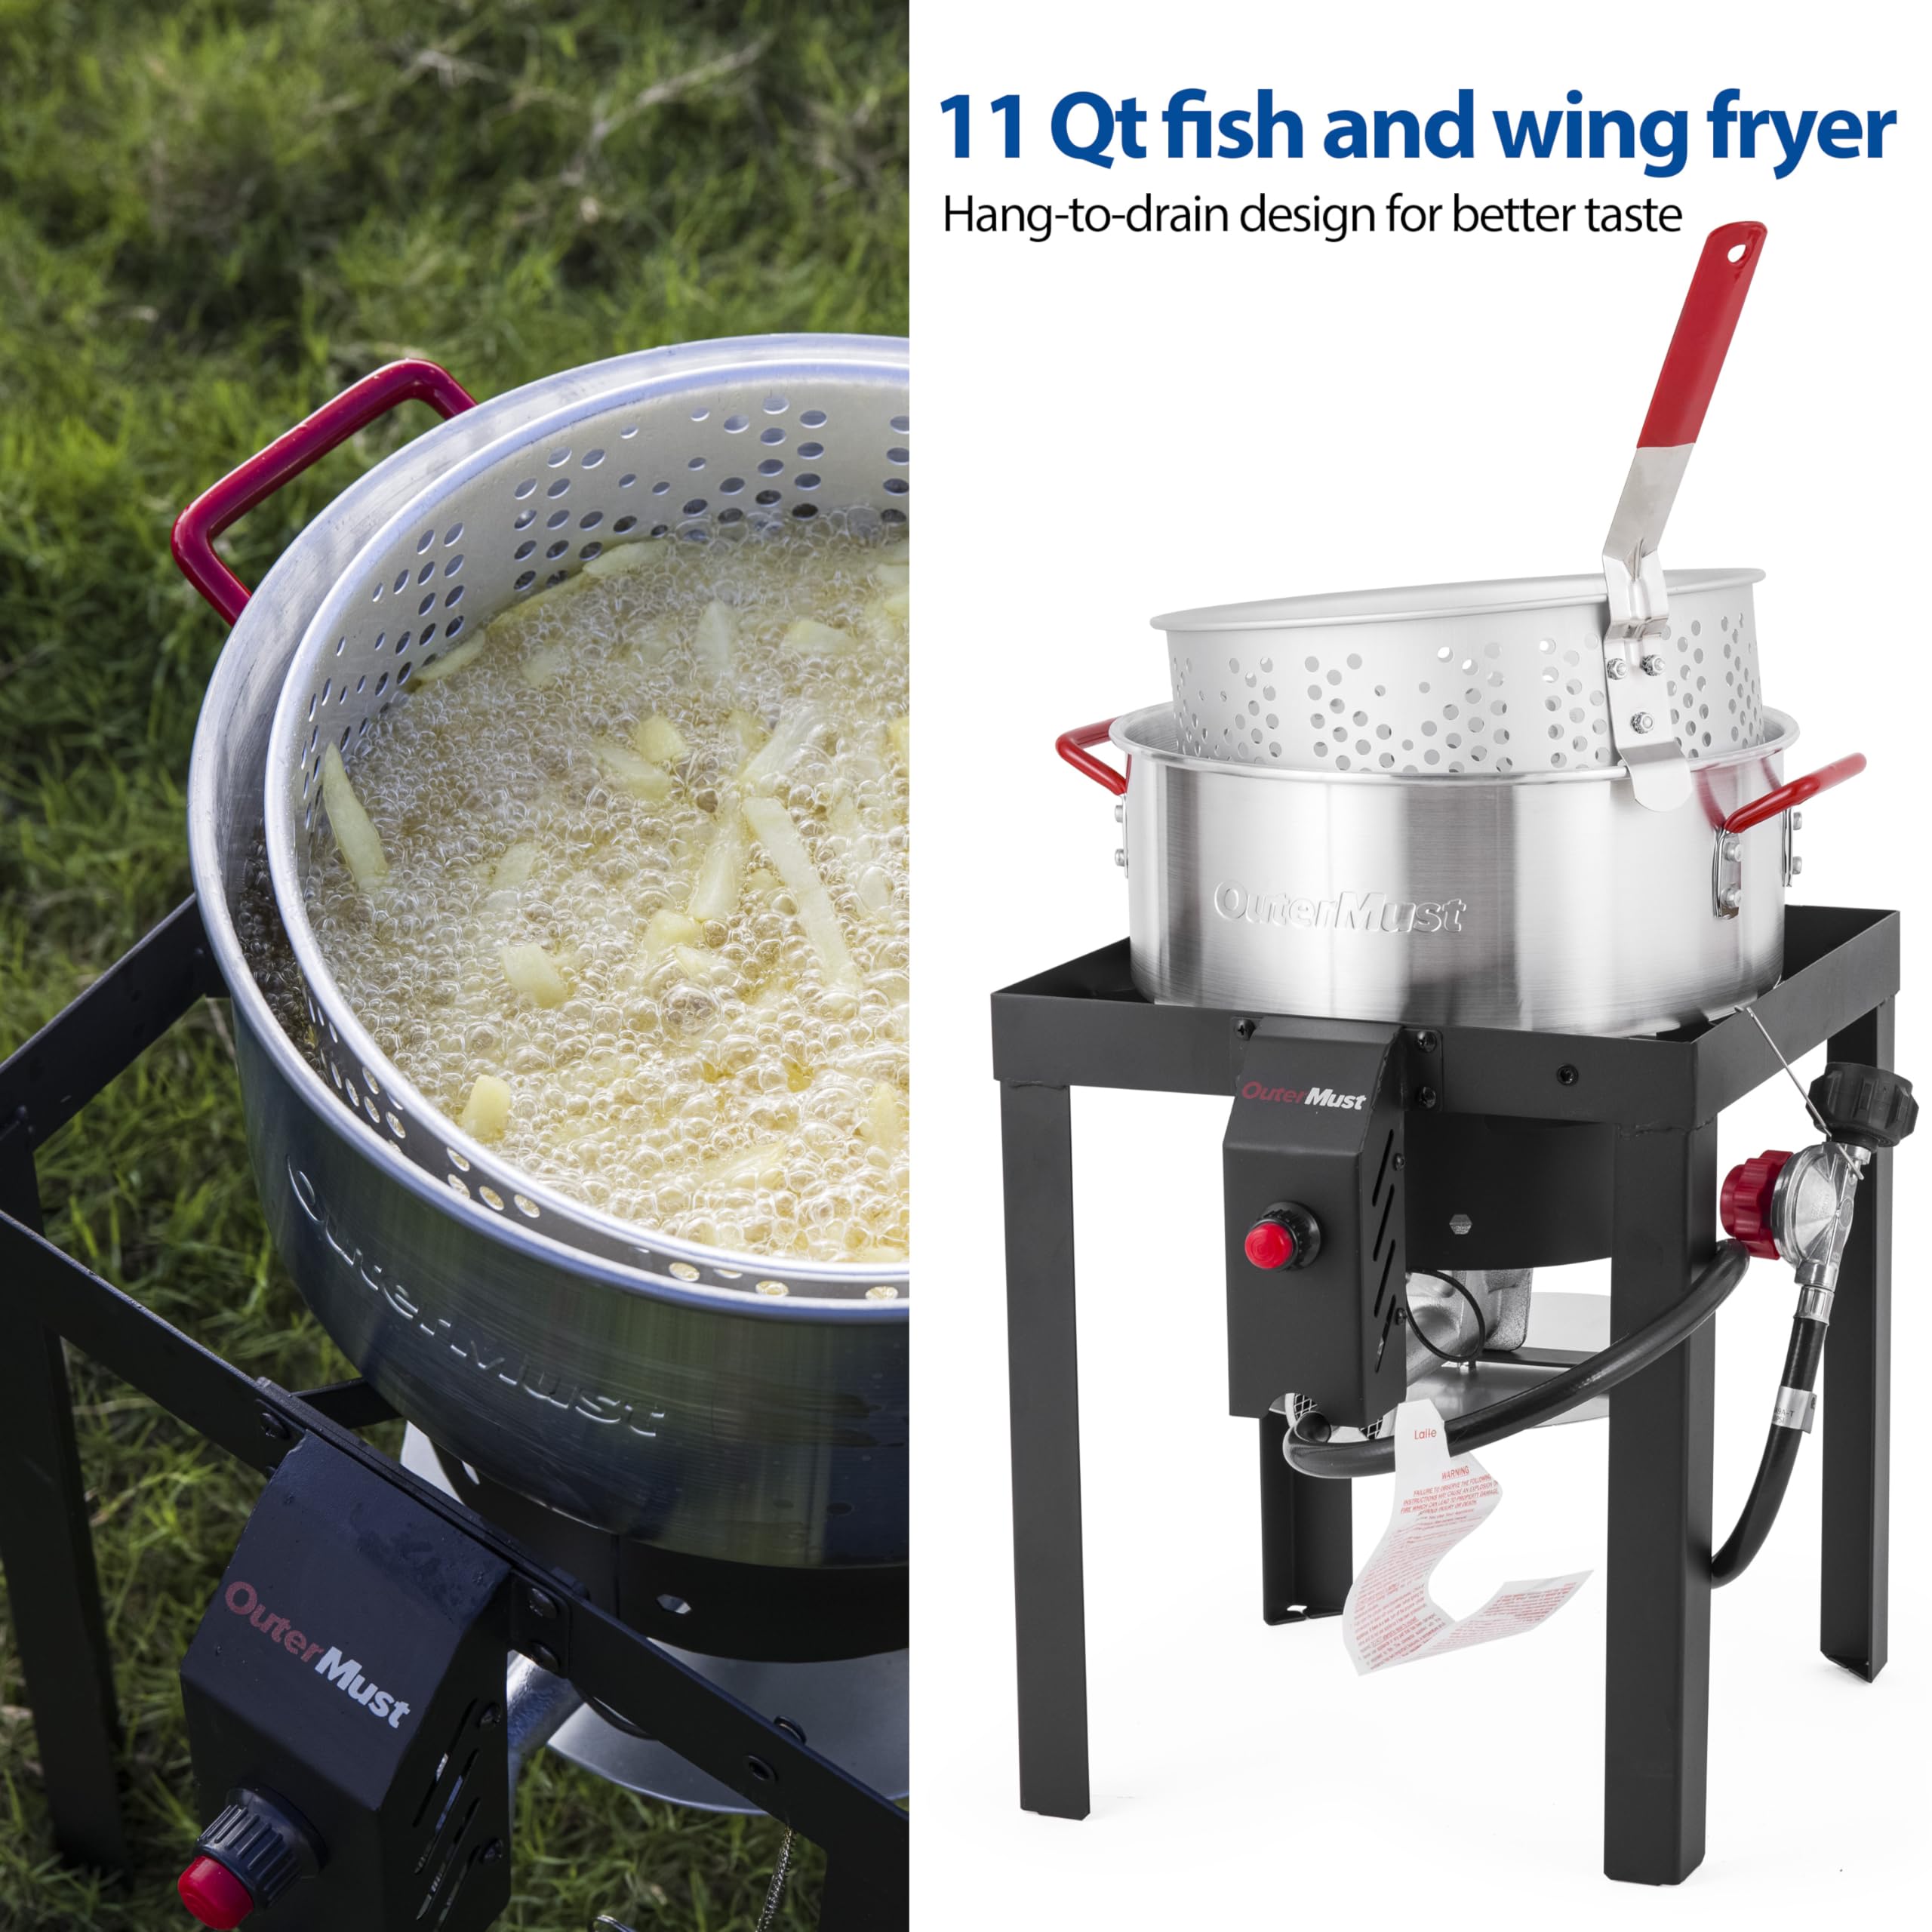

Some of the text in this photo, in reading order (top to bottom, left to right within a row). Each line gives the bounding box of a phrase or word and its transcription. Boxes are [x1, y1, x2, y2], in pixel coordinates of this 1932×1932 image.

[1214, 880, 1466, 933] OuterMust
[1242, 1081, 1367, 1110] OuterMust
[1441, 1466, 1469, 1480] WARNING
[225, 1581, 411, 1728] OuterMust
